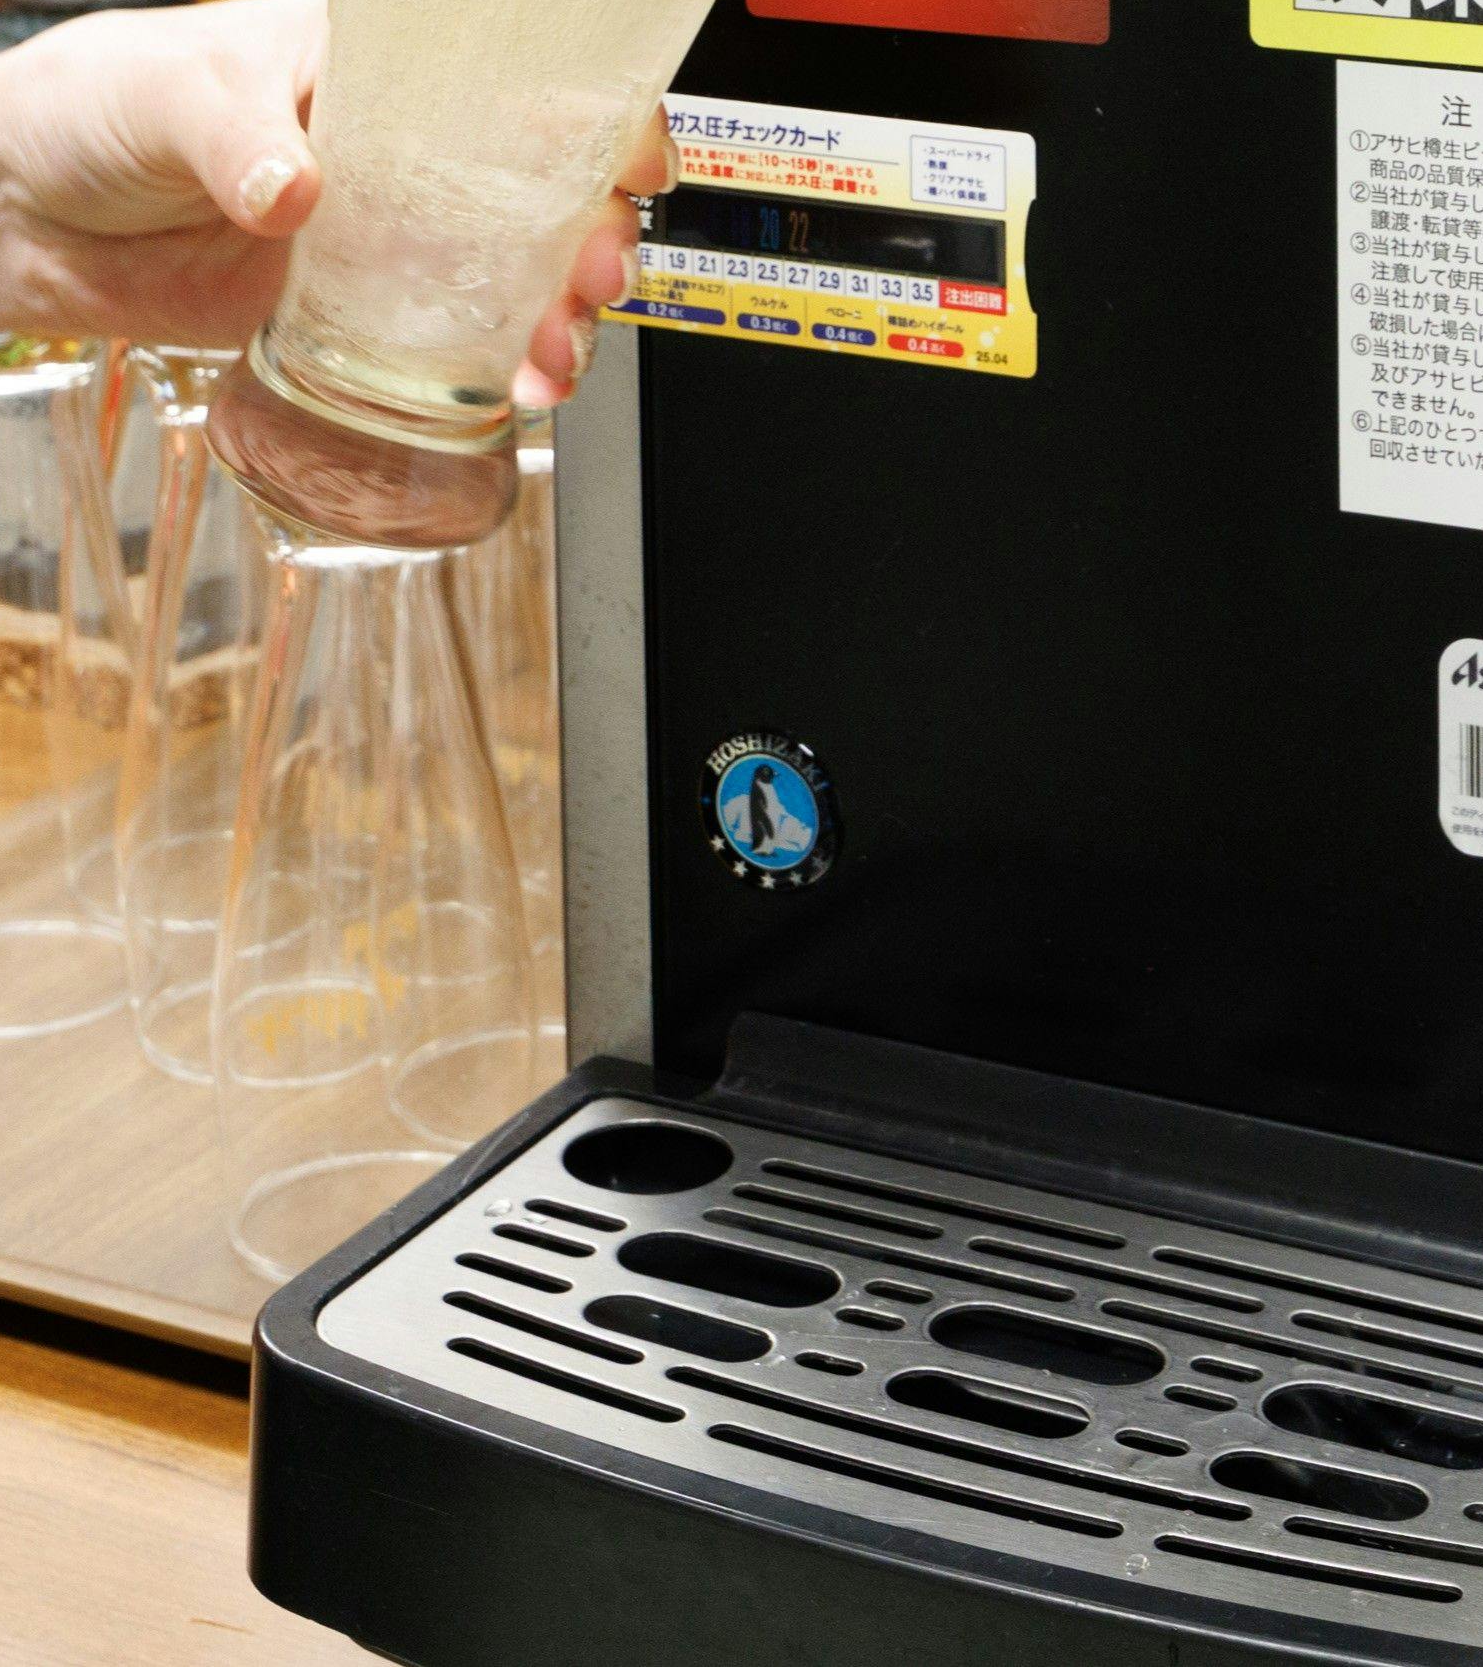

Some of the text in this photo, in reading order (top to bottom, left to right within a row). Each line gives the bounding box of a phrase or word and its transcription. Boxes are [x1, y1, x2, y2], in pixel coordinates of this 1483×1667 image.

[668, 111, 842, 151] ガス圧チェックカード
[698, 254, 717, 273] 2.1
[727, 259, 749, 278] 2.3
[757, 263, 780, 282] 2.5
[788, 266, 809, 285] 2.7
[819, 271, 841, 290] 2.9
[852, 275, 869, 294] 3.1
[882, 279, 902, 298] 3.3
[912, 283, 933, 302] 3.5
[976, 351, 1009, 366] 25.04
[1373, 390, 1479, 421] できません。
